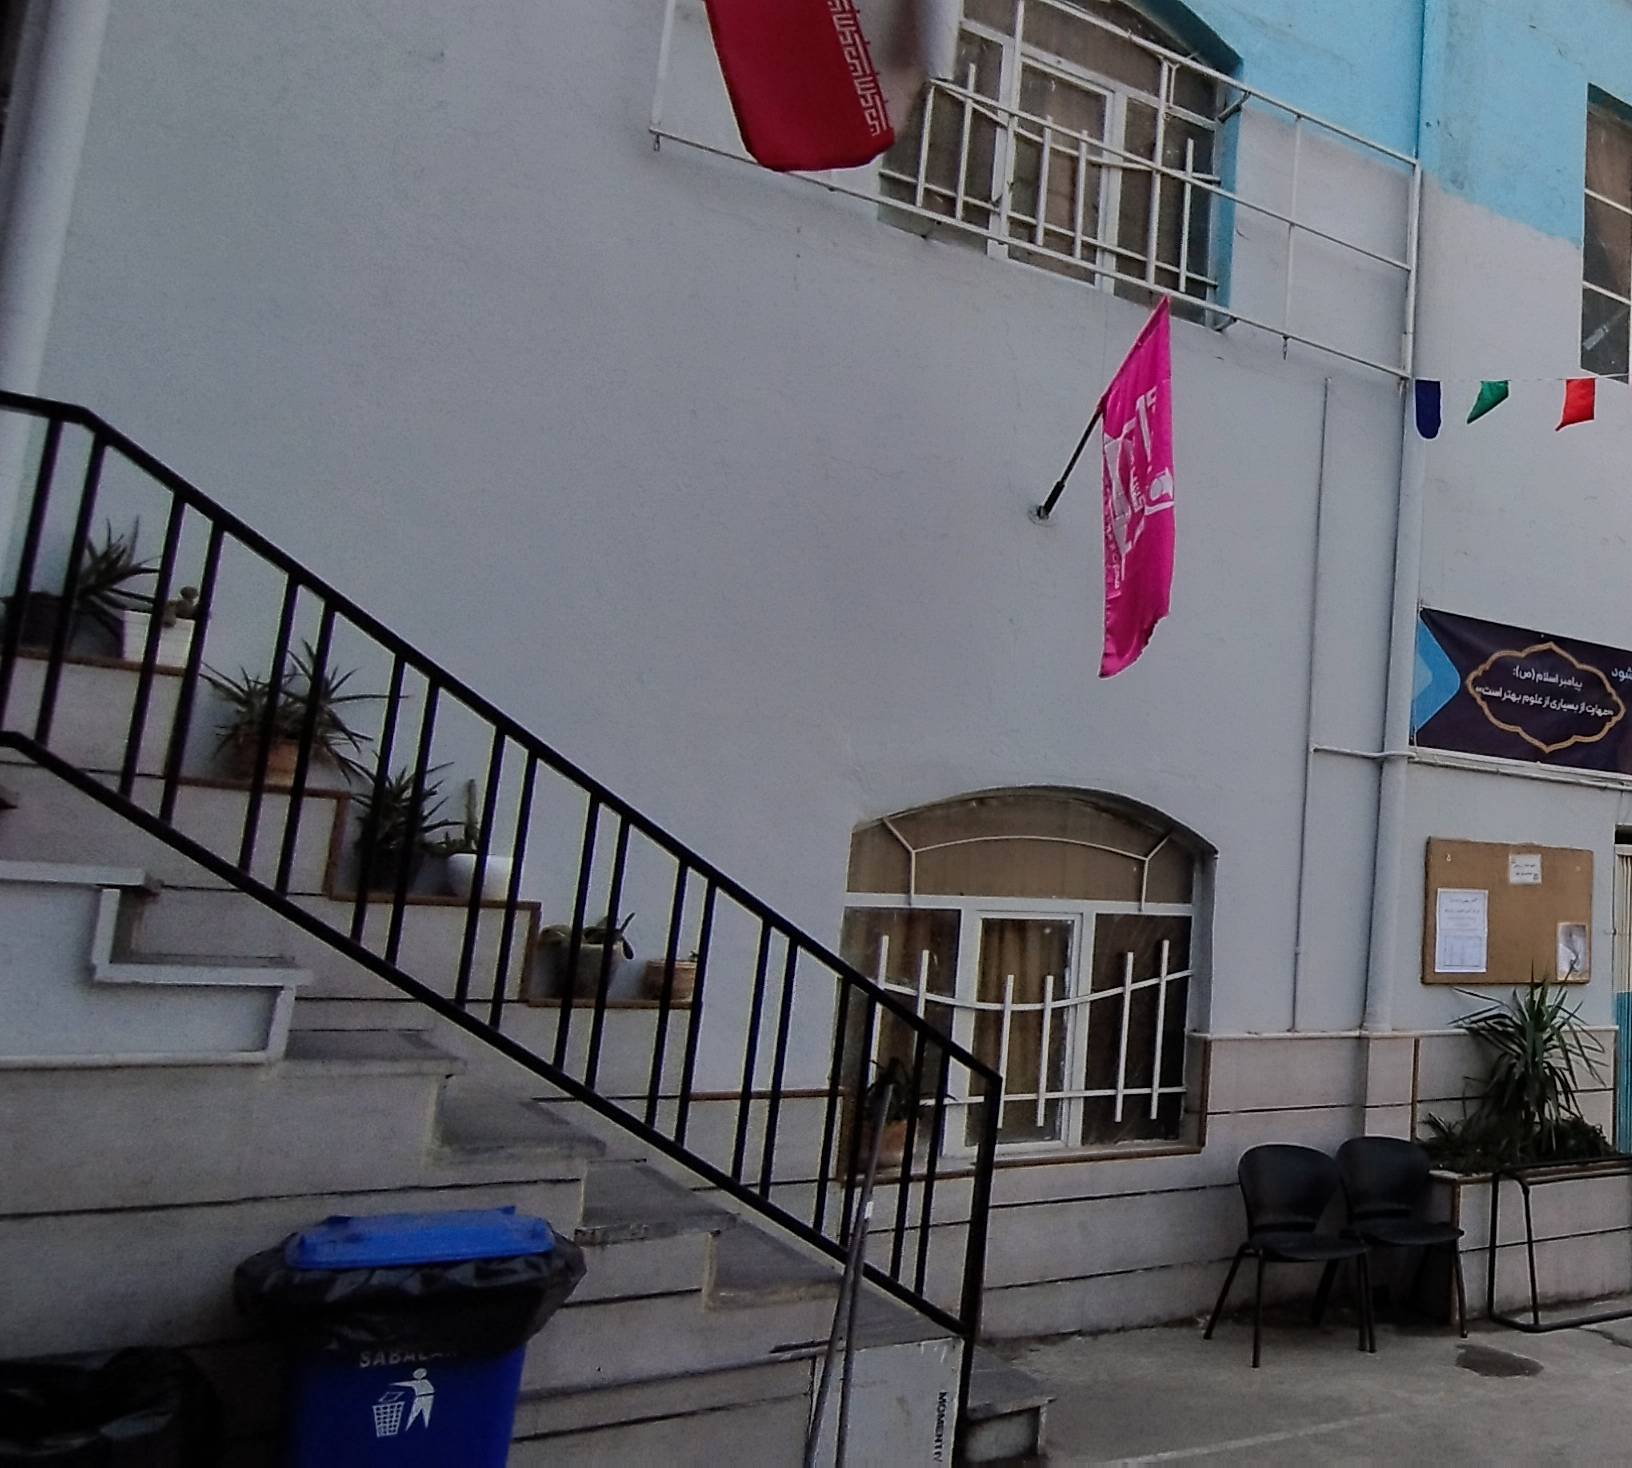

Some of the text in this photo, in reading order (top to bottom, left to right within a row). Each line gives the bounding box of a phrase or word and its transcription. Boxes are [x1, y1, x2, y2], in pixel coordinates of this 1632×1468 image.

[1535, 672, 1559, 683] اسلام
[1559, 676, 1583, 692] پیامبر
[1501, 689, 1522, 702] بهتر
[1521, 693, 1543, 705] علوم
[1542, 695, 1551, 708] از
[1550, 698, 1579, 713] بسیاری
[1578, 701, 1586, 714] از
